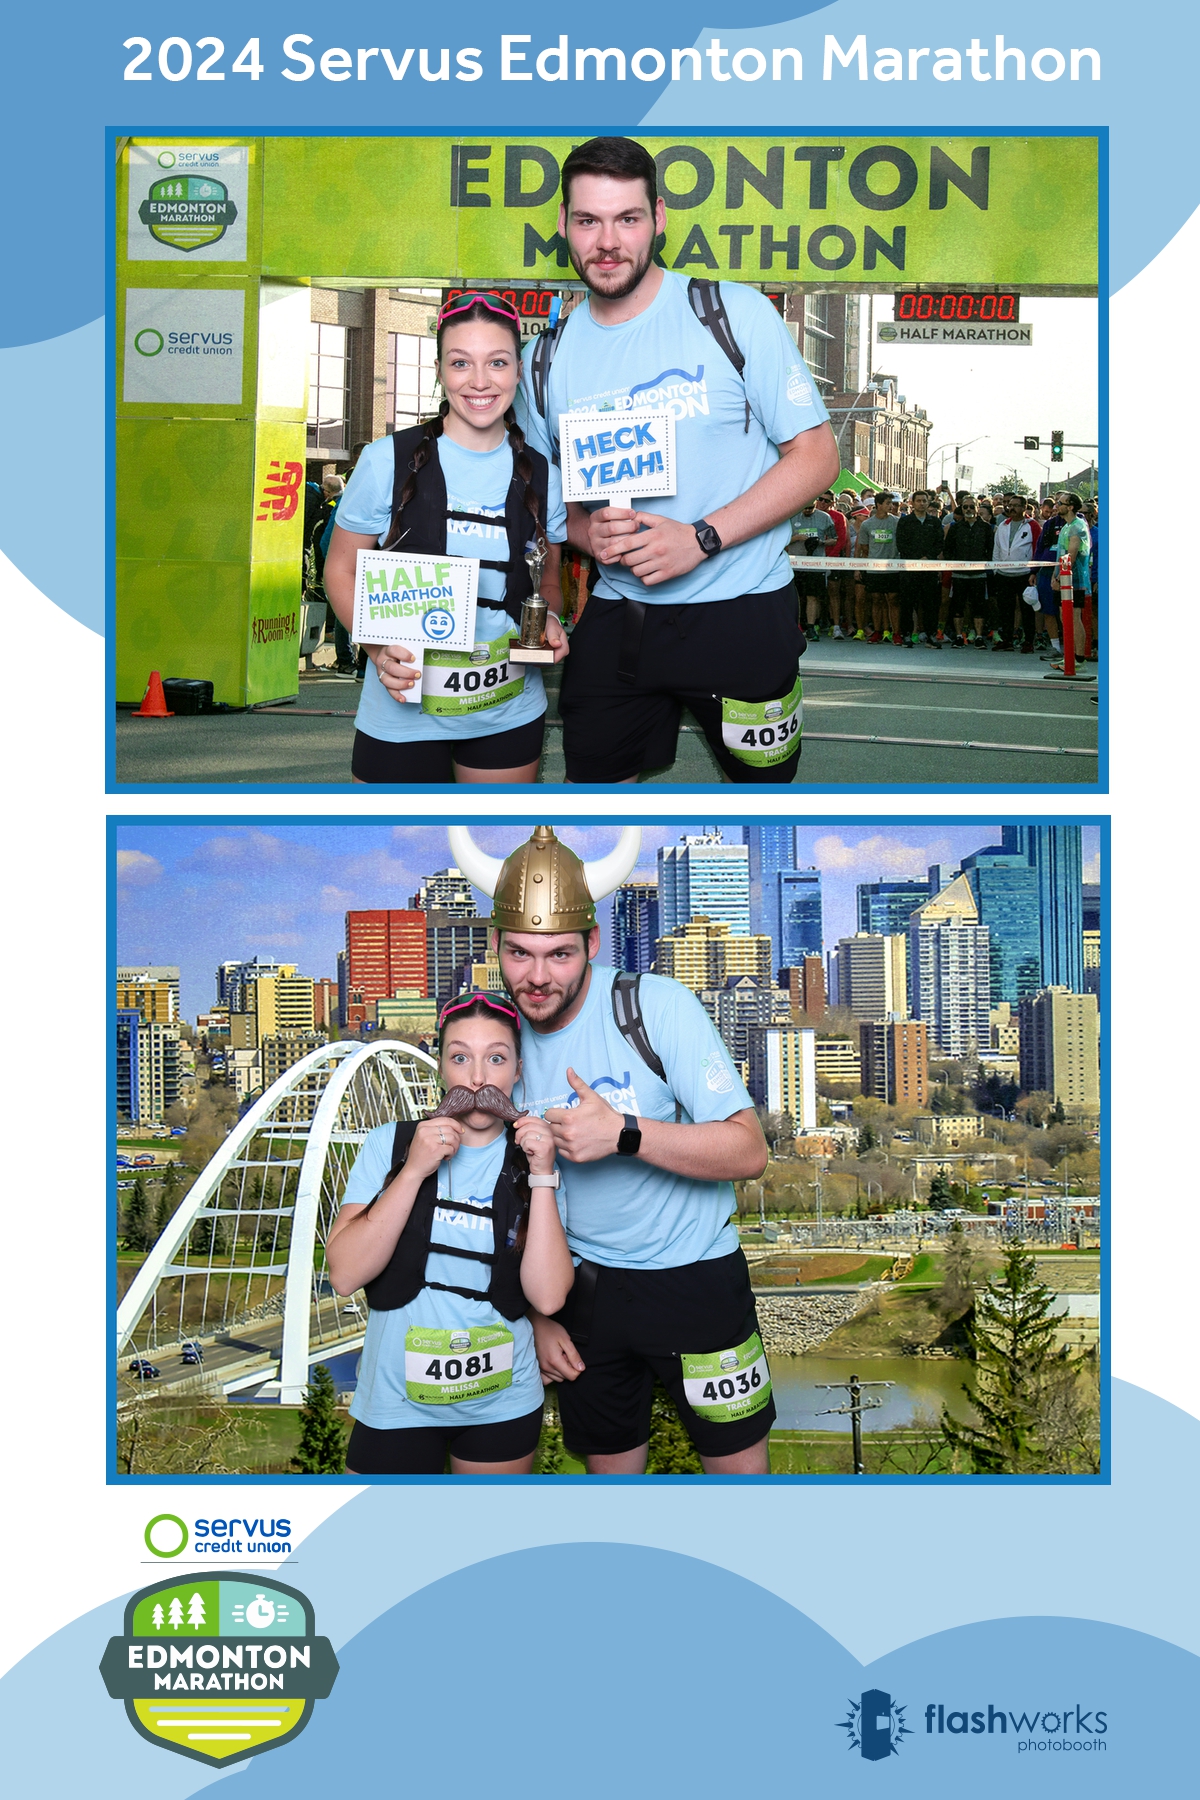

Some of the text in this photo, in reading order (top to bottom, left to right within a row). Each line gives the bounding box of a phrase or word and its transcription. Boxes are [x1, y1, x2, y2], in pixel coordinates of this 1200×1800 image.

[178, 152, 219, 161] servus
[450, 144, 989, 211] EDONTON
[149, 202, 227, 214] EDMONTON
[160, 214, 215, 222] MARATHON
[168, 332, 233, 345] servus
[900, 328, 1031, 341] HALF MARATHON
[168, 345, 233, 355] credit union
[614, 379, 707, 411] EDMONTON
[573, 422, 657, 461] HECK
[578, 450, 664, 490] YEAH!
[365, 562, 451, 593] HALF
[368, 585, 453, 605] MARATHON
[369, 598, 456, 620] FINISHER!
[258, 613, 290, 634] Running
[443, 663, 509, 693] 4081
[459, 692, 496, 705] MELISSA
[467, 692, 514, 712] HALF MARATHON
[741, 713, 798, 747] 4036
[763, 745, 788, 758] TRACE
[425, 1352, 493, 1380] 4081
[441, 1382, 480, 1394] MELISSA
[466, 1384, 500, 1398] MARATHON
[703, 1366, 761, 1400] 4036
[726, 1398, 752, 1411] TRACE
[731, 1409, 746, 1418] HALF
